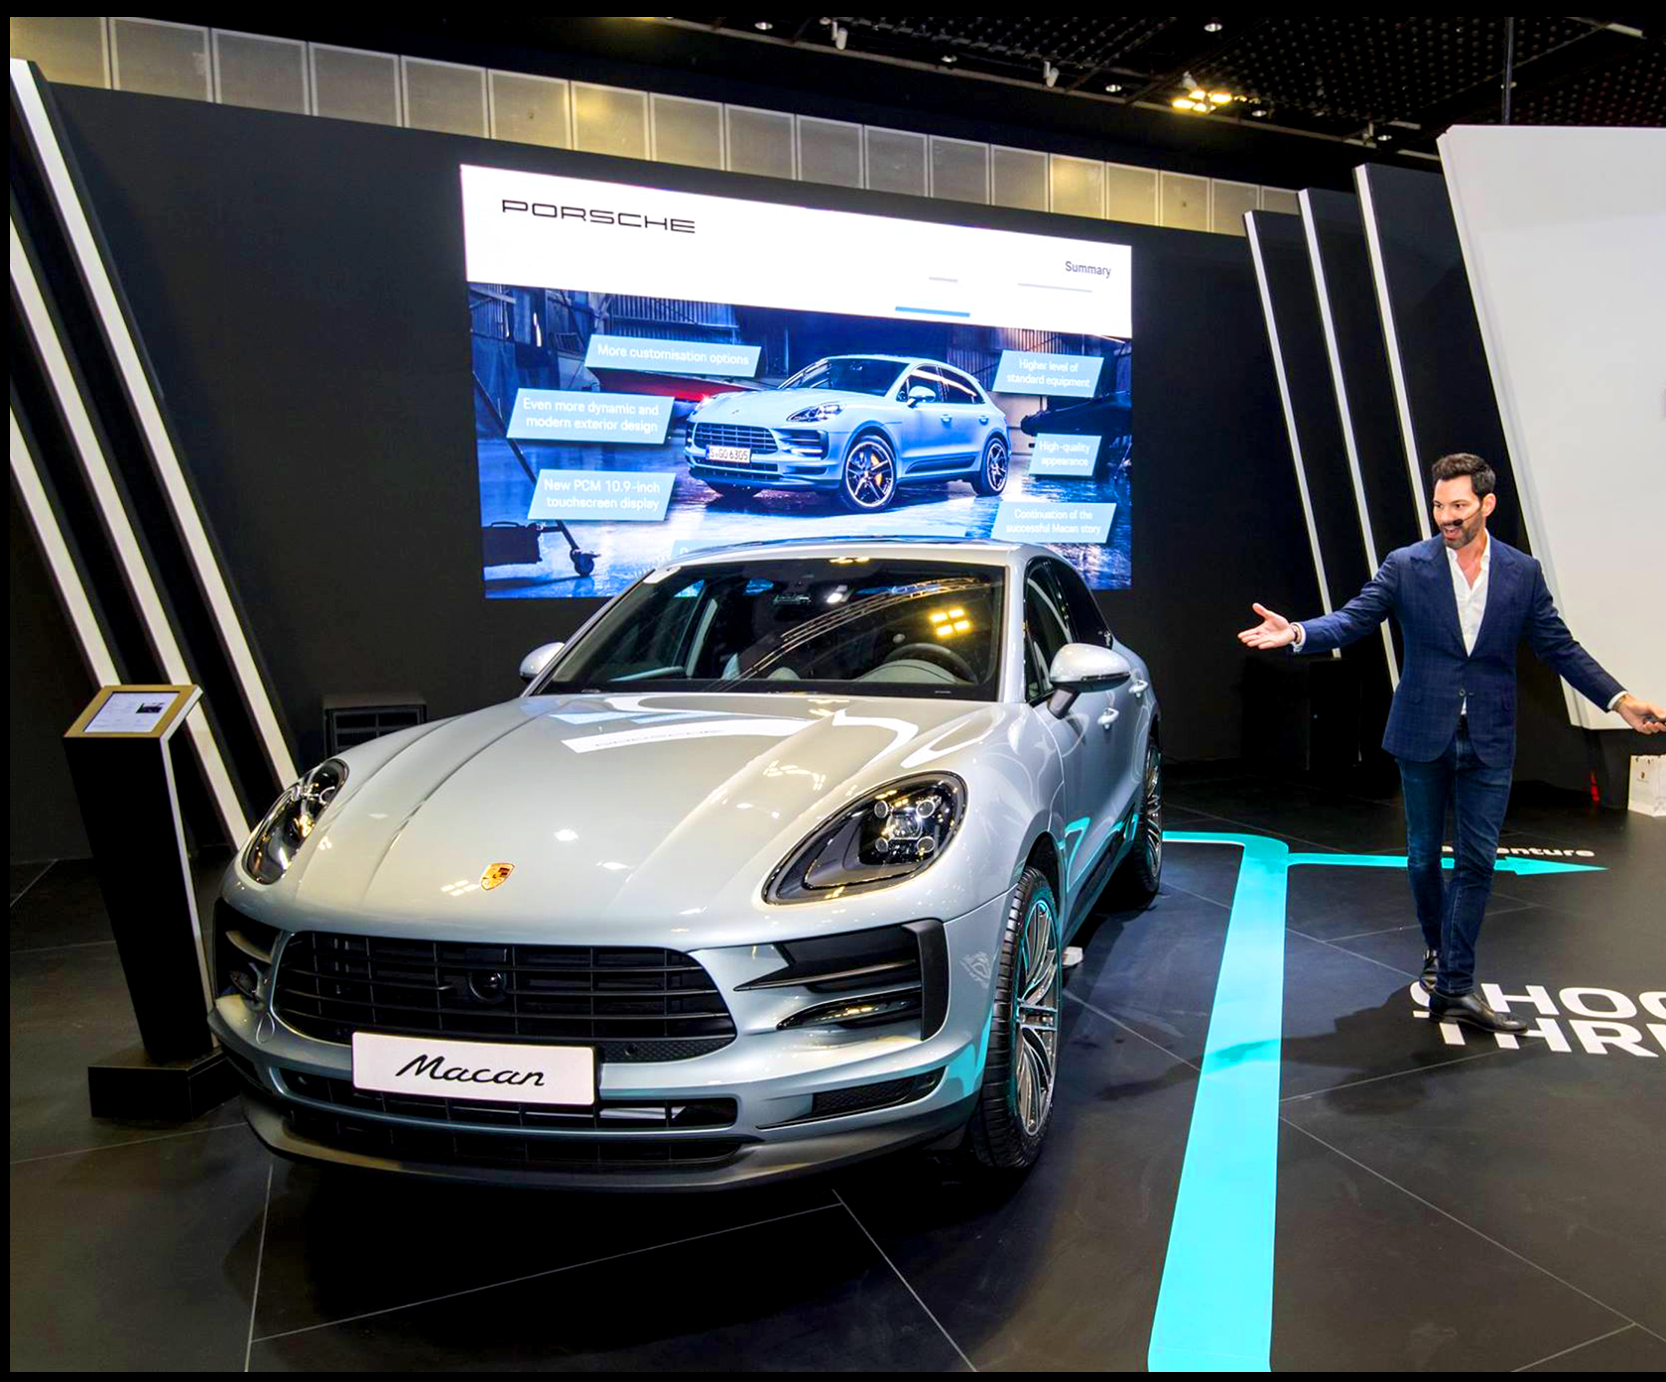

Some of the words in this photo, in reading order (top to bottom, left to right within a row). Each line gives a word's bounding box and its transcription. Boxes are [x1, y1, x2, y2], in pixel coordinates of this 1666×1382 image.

[502, 199, 696, 234] PORSCHE
[1065, 260, 1112, 279] Summary
[597, 343, 628, 357] More
[629, 347, 707, 363] customisation
[709, 353, 750, 366] options
[1019, 358, 1048, 372] Higher
[1049, 361, 1068, 373] level
[1069, 363, 1079, 372] of
[1006, 373, 1045, 385] standard
[1046, 375, 1091, 388] equipment
[523, 397, 552, 412] Even
[554, 402, 586, 414] more
[587, 401, 636, 417] dynamic
[638, 404, 660, 416] and
[526, 414, 572, 428] modern
[574, 417, 619, 431] exterior
[620, 419, 658, 434] design
[1039, 440, 1092, 455] High-quality
[1041, 457, 1089, 467] appearance
[543, 479, 571, 492] New
[573, 479, 601, 492] PCM
[605, 480, 661, 494] 10.9-inch
[546, 496, 618, 508] touchscreen
[619, 497, 659, 511] display
[1014, 508, 1068, 519] Continuation
[1069, 509, 1078, 519] of
[1079, 509, 1093, 519] the
[1006, 522, 1050, 533] successful
[1052, 523, 1079, 533] Macan
[1081, 524, 1101, 536] story
[395, 1053, 545, 1086] Macan
